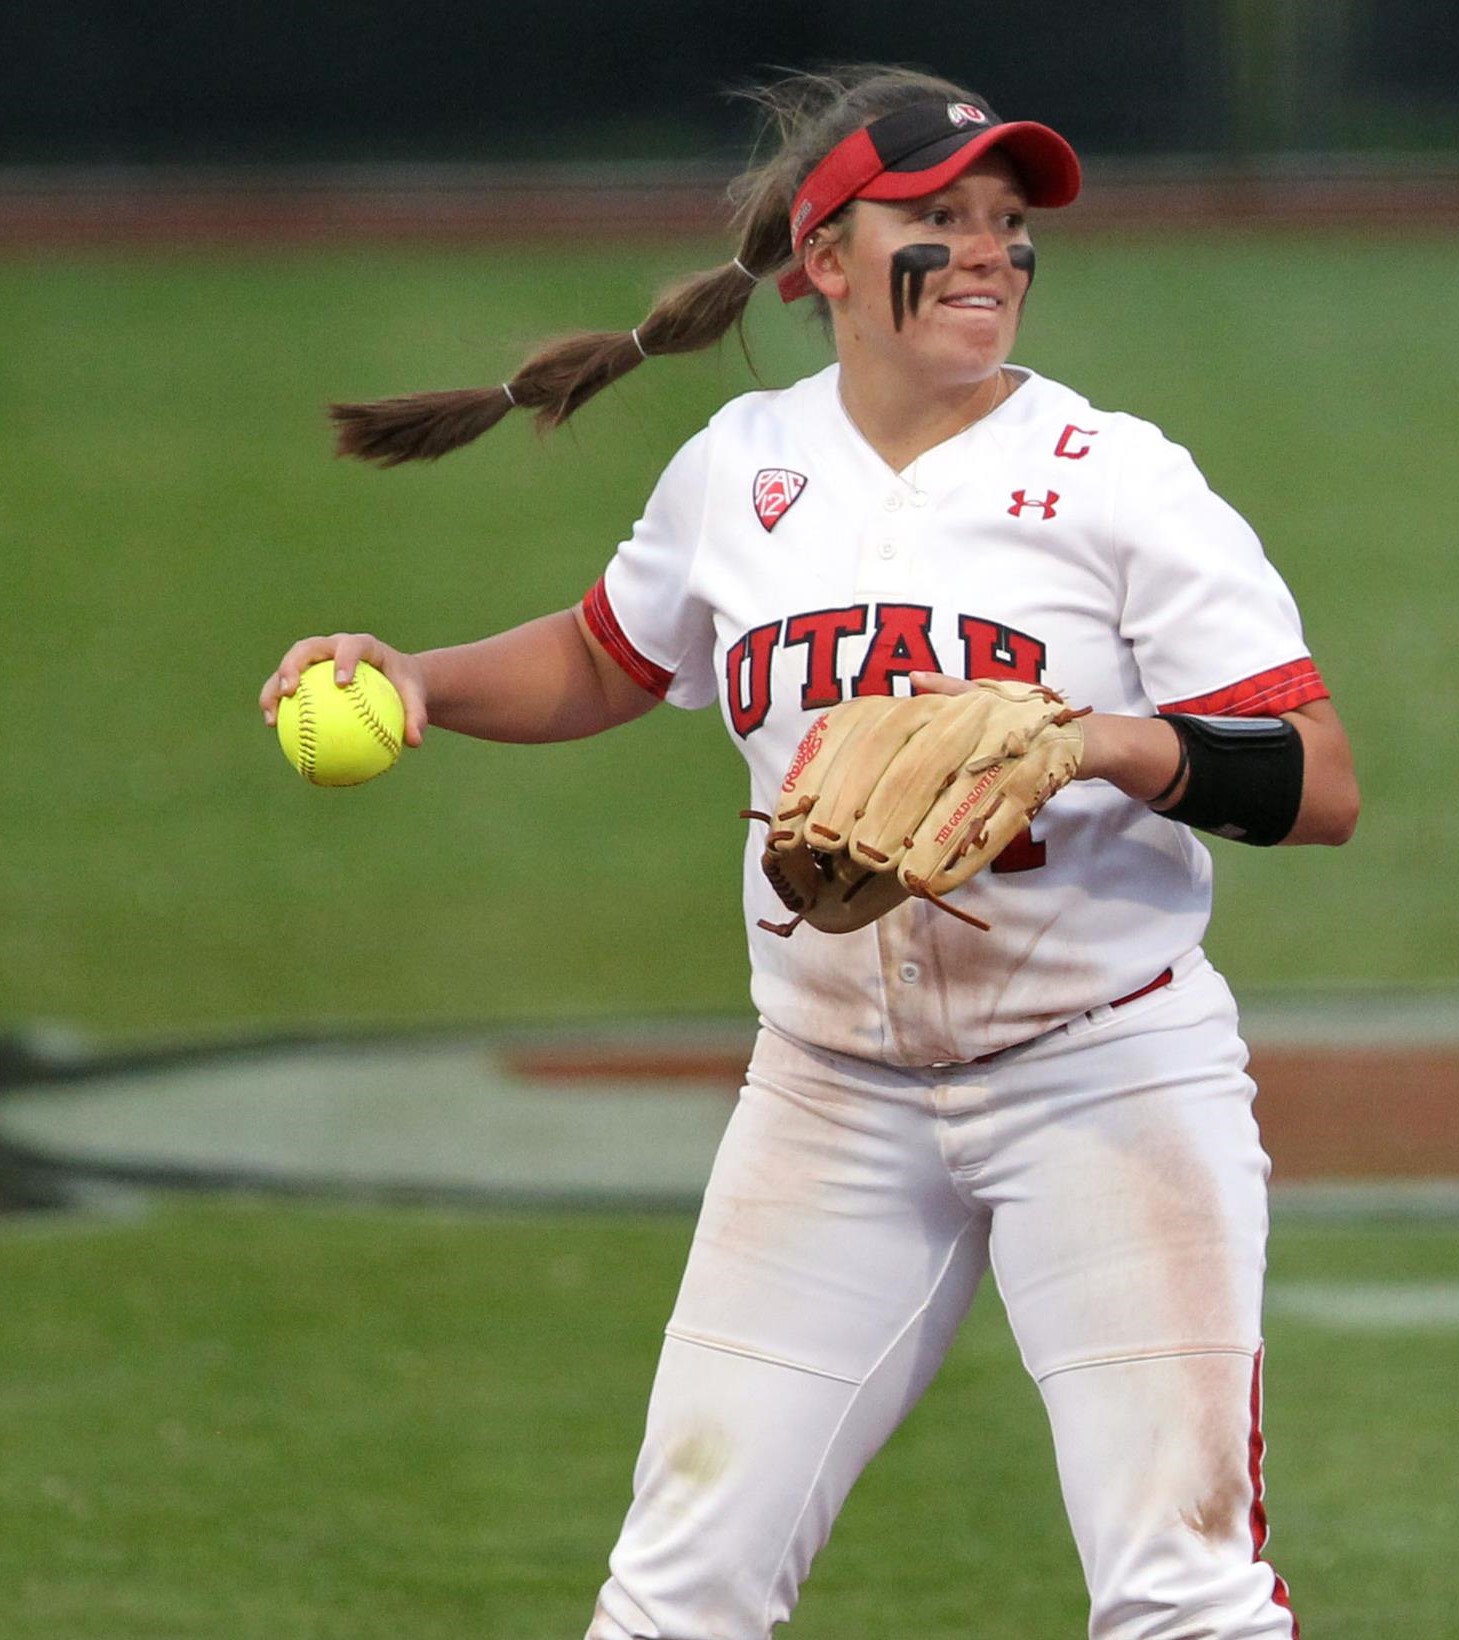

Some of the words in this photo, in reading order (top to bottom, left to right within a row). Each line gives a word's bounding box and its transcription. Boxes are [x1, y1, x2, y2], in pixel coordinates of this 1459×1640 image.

[1053, 424, 1099, 460] C
[755, 469, 806, 505] PAC
[760, 493, 785, 516] 12
[726, 602, 1047, 741] UTAH
[934, 824, 953, 845] THE
[949, 802, 971, 827] GOLD
[967, 775, 992, 805] GLOVE
